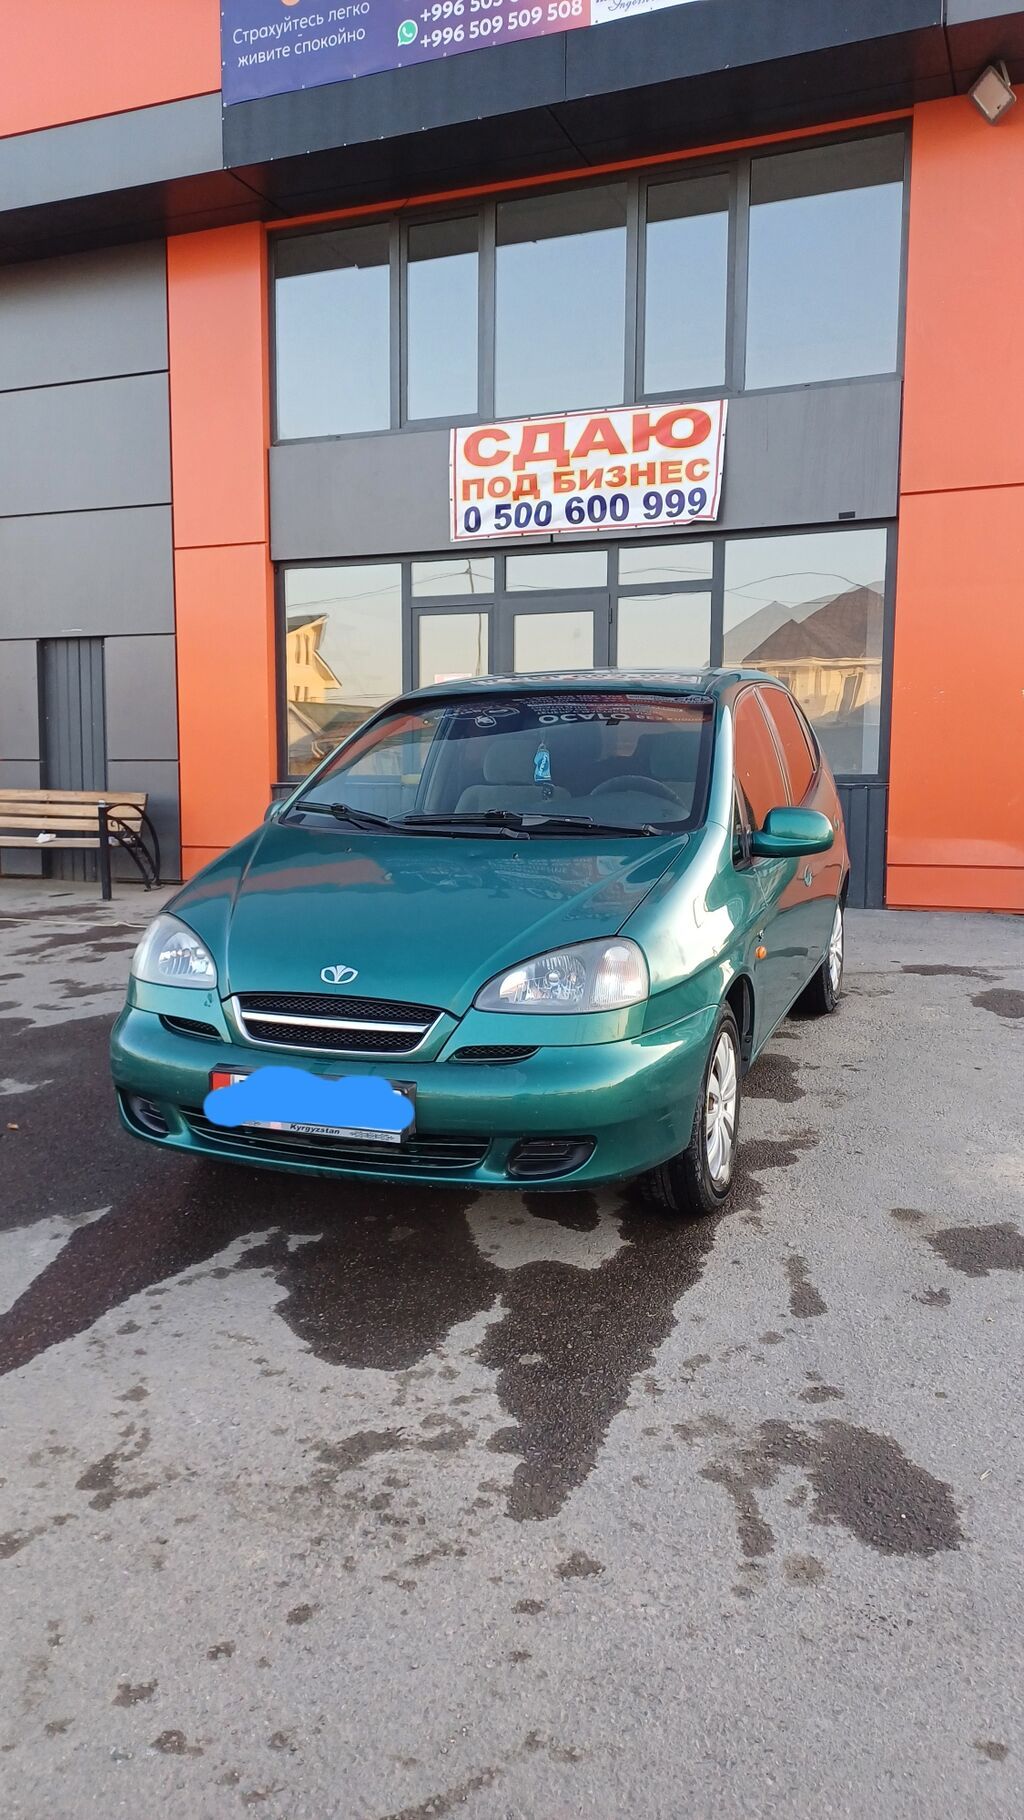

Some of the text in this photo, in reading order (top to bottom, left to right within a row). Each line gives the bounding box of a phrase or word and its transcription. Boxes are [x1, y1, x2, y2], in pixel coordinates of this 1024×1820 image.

[232, 2, 370, 45] Страхуйтесь легко
[420, 0, 465, 22] +996
[420, 0, 583, 48] +996 509 509 508
[237, 27, 366, 67] живите спокойно
[463, 408, 712, 472] СДАЮ
[461, 458, 710, 501] ПОД БИЗНЕС
[463, 487, 708, 533] 0 500 600 999
[289, 1123, 341, 1136] Kyrgyzstan
